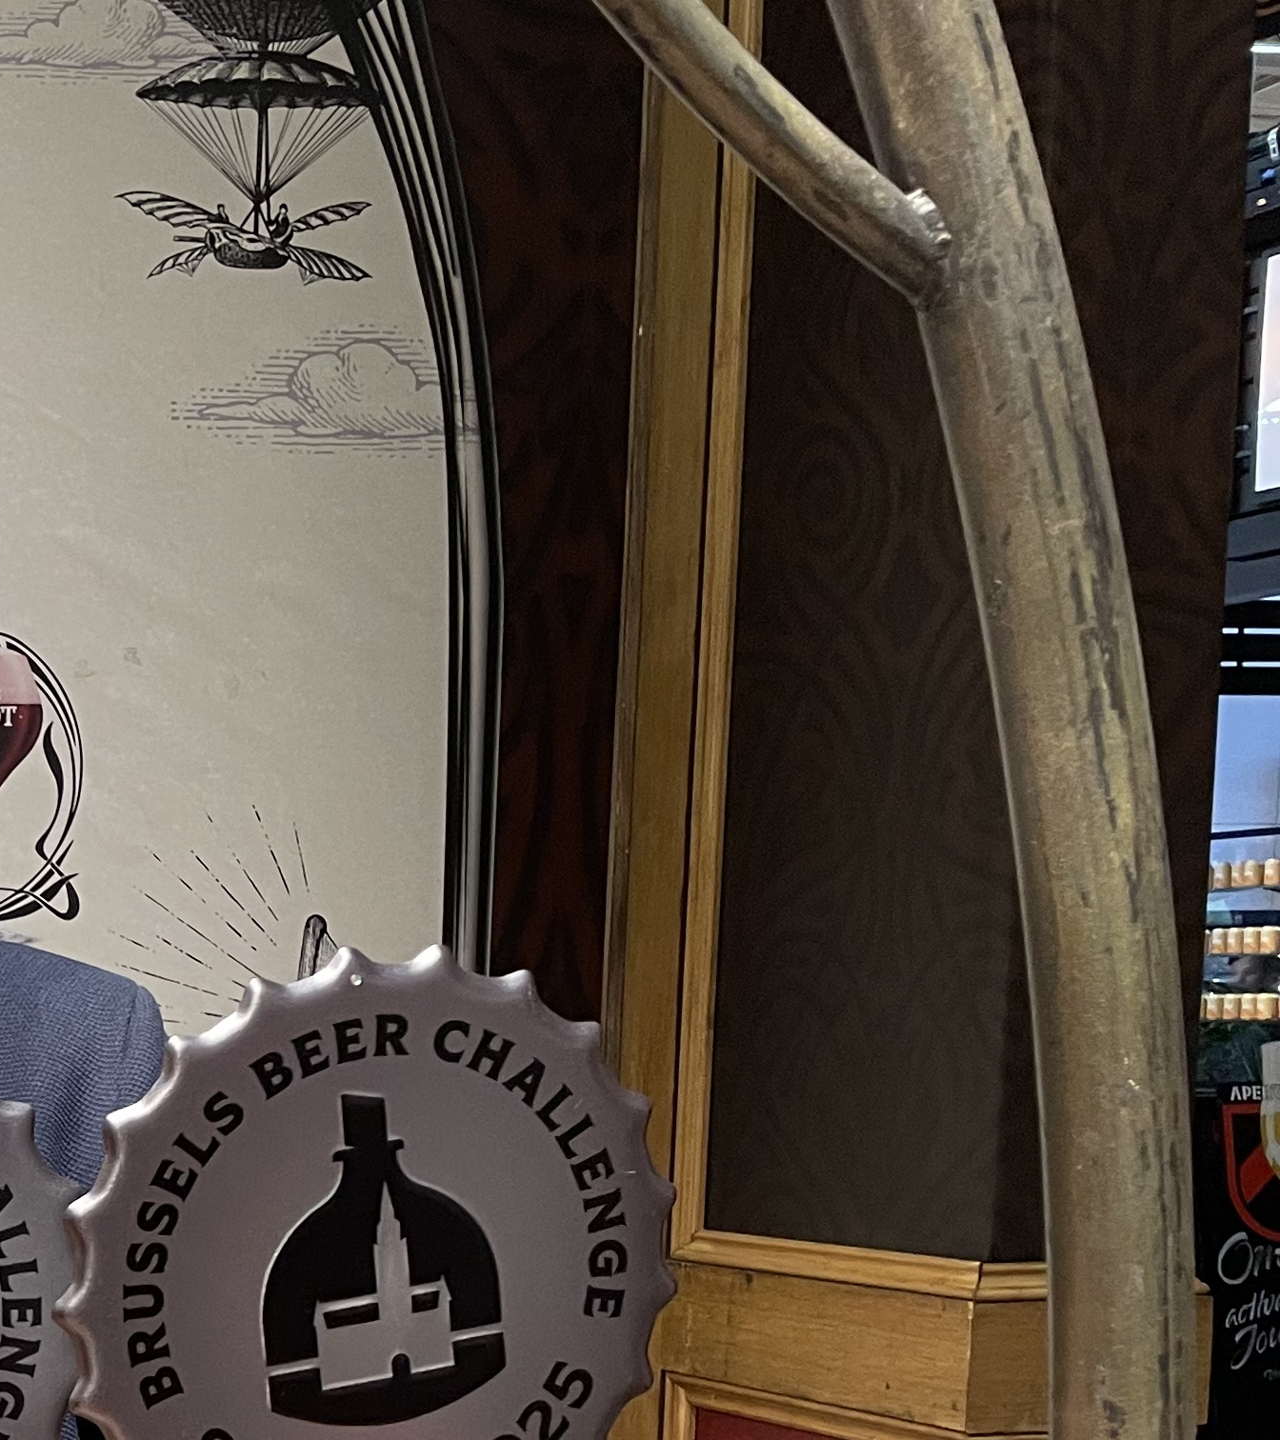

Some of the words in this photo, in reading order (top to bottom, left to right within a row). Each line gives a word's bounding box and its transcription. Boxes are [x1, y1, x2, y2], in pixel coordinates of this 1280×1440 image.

[122, 1090, 245, 1411] BRUSSELS
[248, 1013, 410, 1101] BEER
[432, 1019, 628, 1320] CHALLENGE
